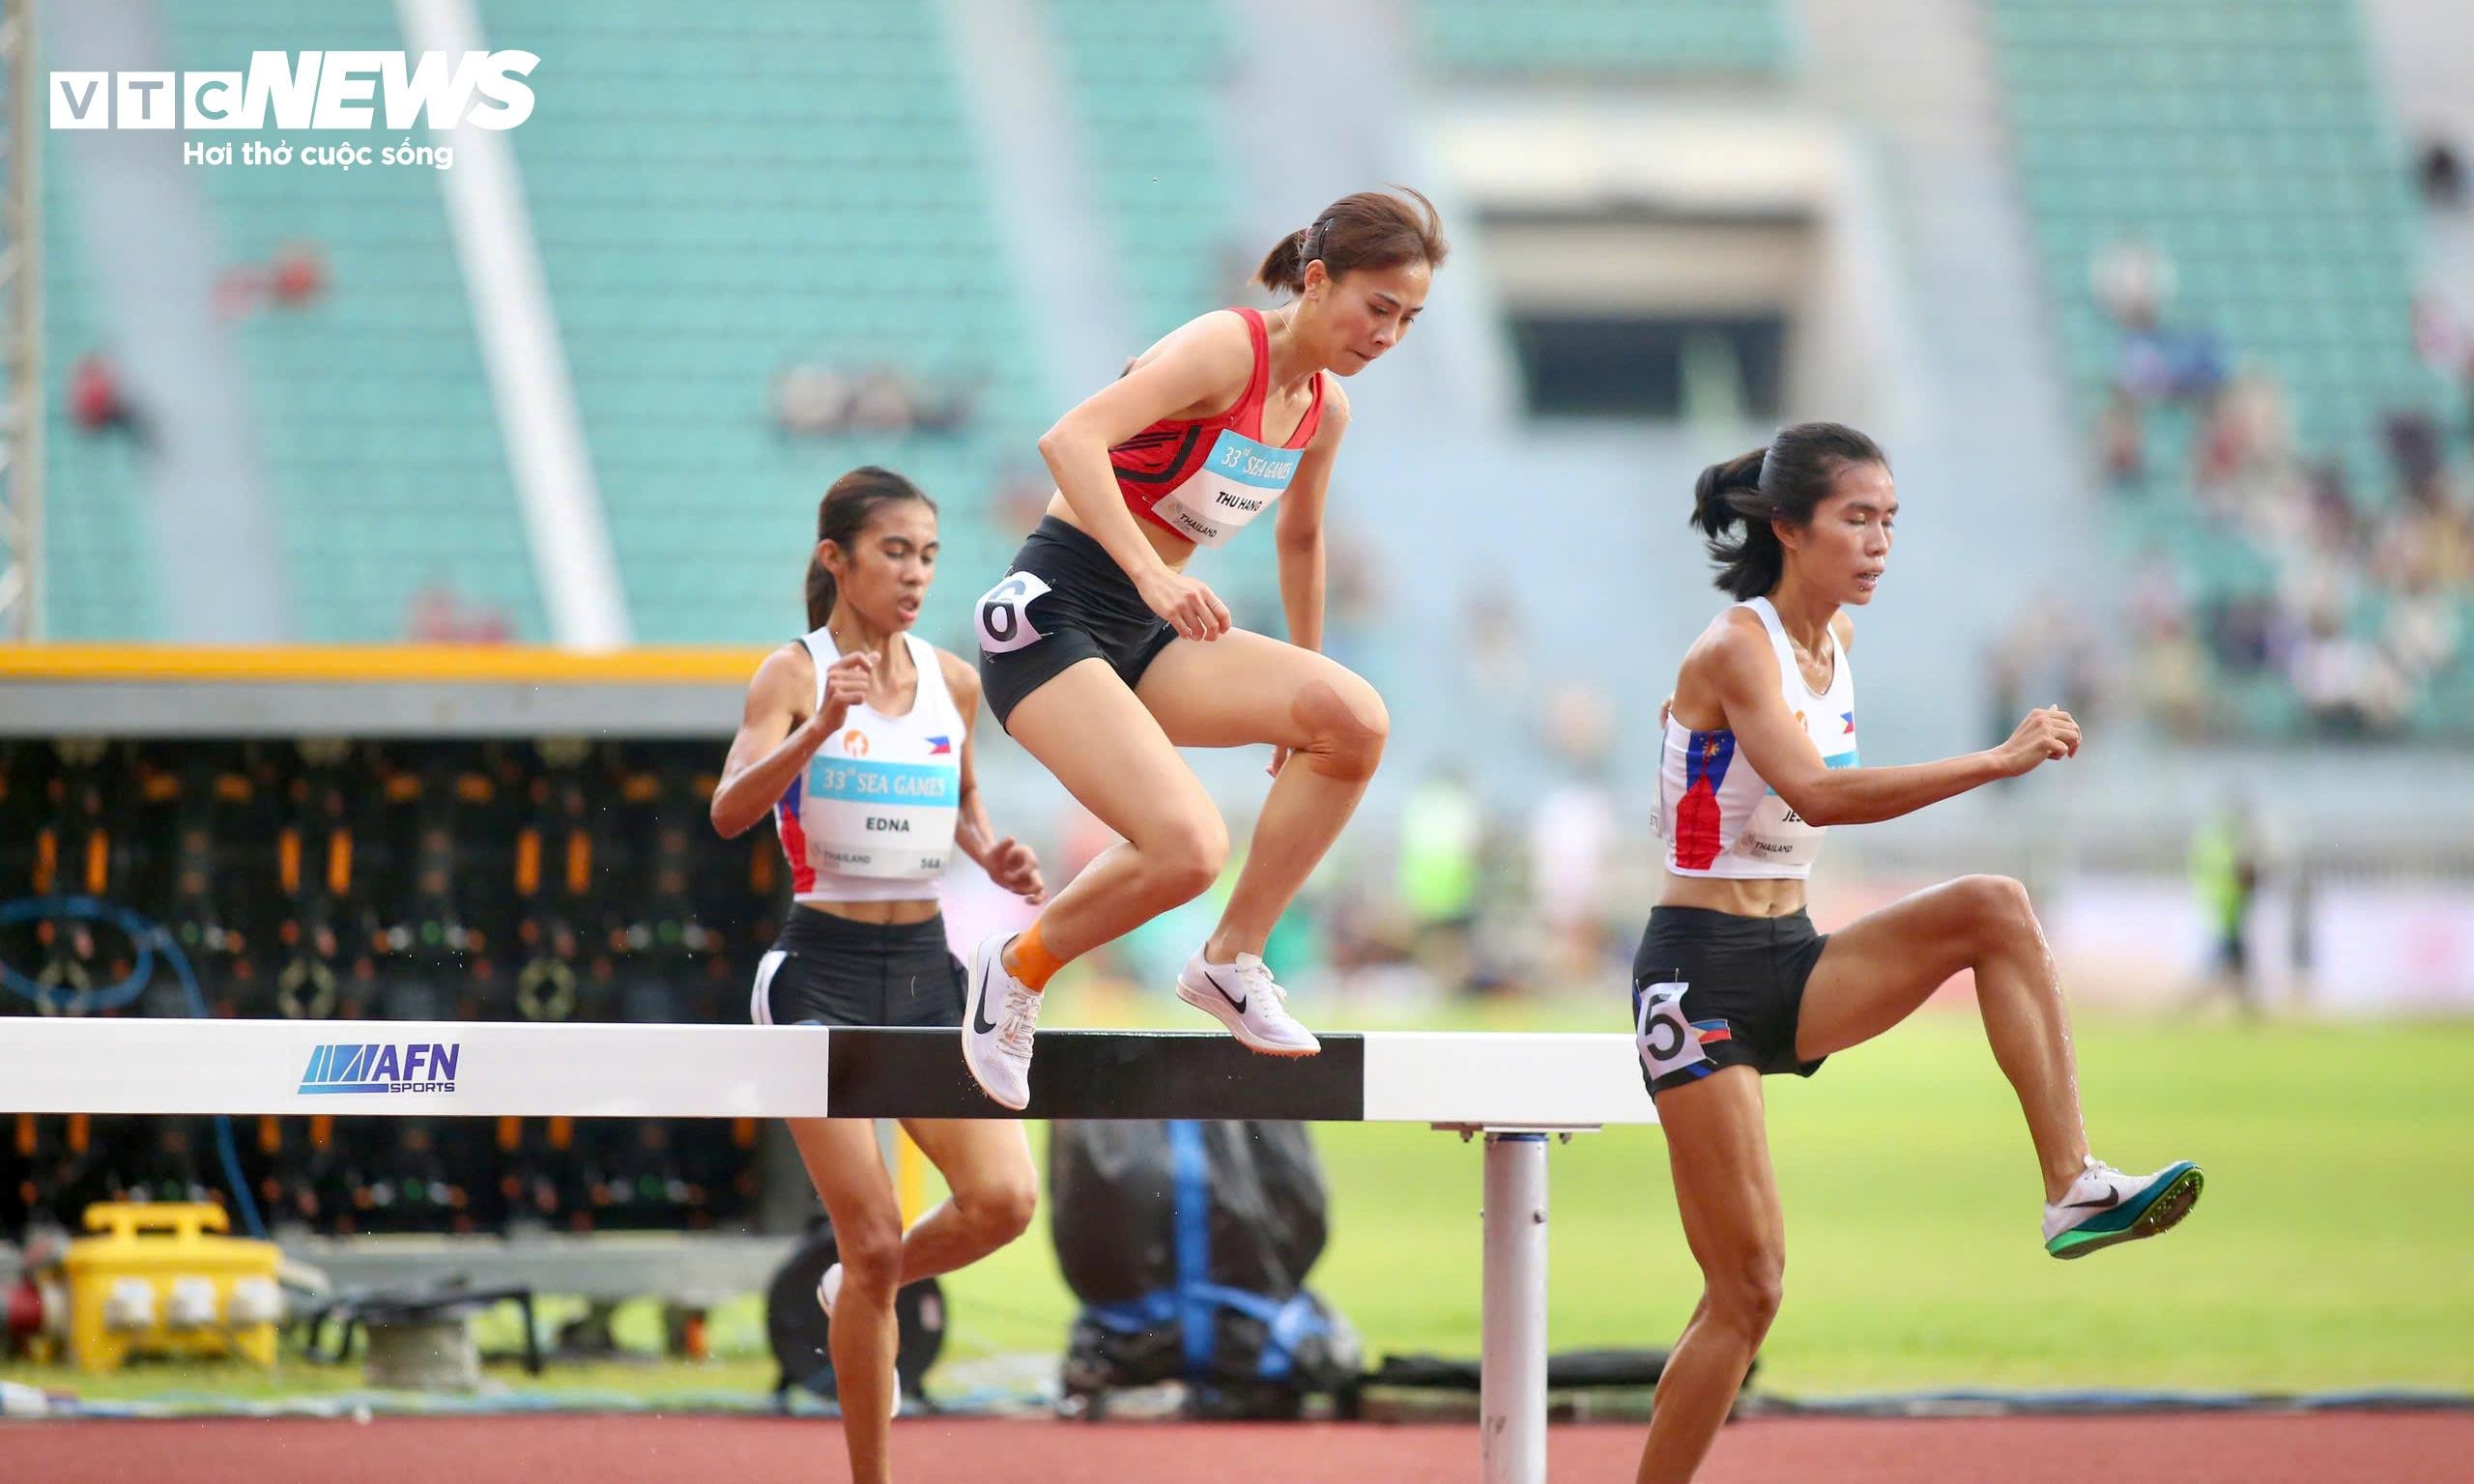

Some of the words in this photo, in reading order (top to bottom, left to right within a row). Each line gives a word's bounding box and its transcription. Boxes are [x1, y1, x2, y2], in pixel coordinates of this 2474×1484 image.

[1216, 491, 1240, 508] THU
[1237, 498, 1263, 512] HANG
[1179, 513, 1218, 538] THAILAND
[982, 580, 1026, 642] 6
[857, 772, 889, 794] SEA
[894, 774, 946, 797] GAMES
[866, 817, 910, 833] EDNA
[1754, 842, 1794, 853] THAILAND
[1645, 993, 1685, 1062] 5
[371, 1043, 460, 1082] AFN
[389, 1082, 456, 1094] SPORTS
